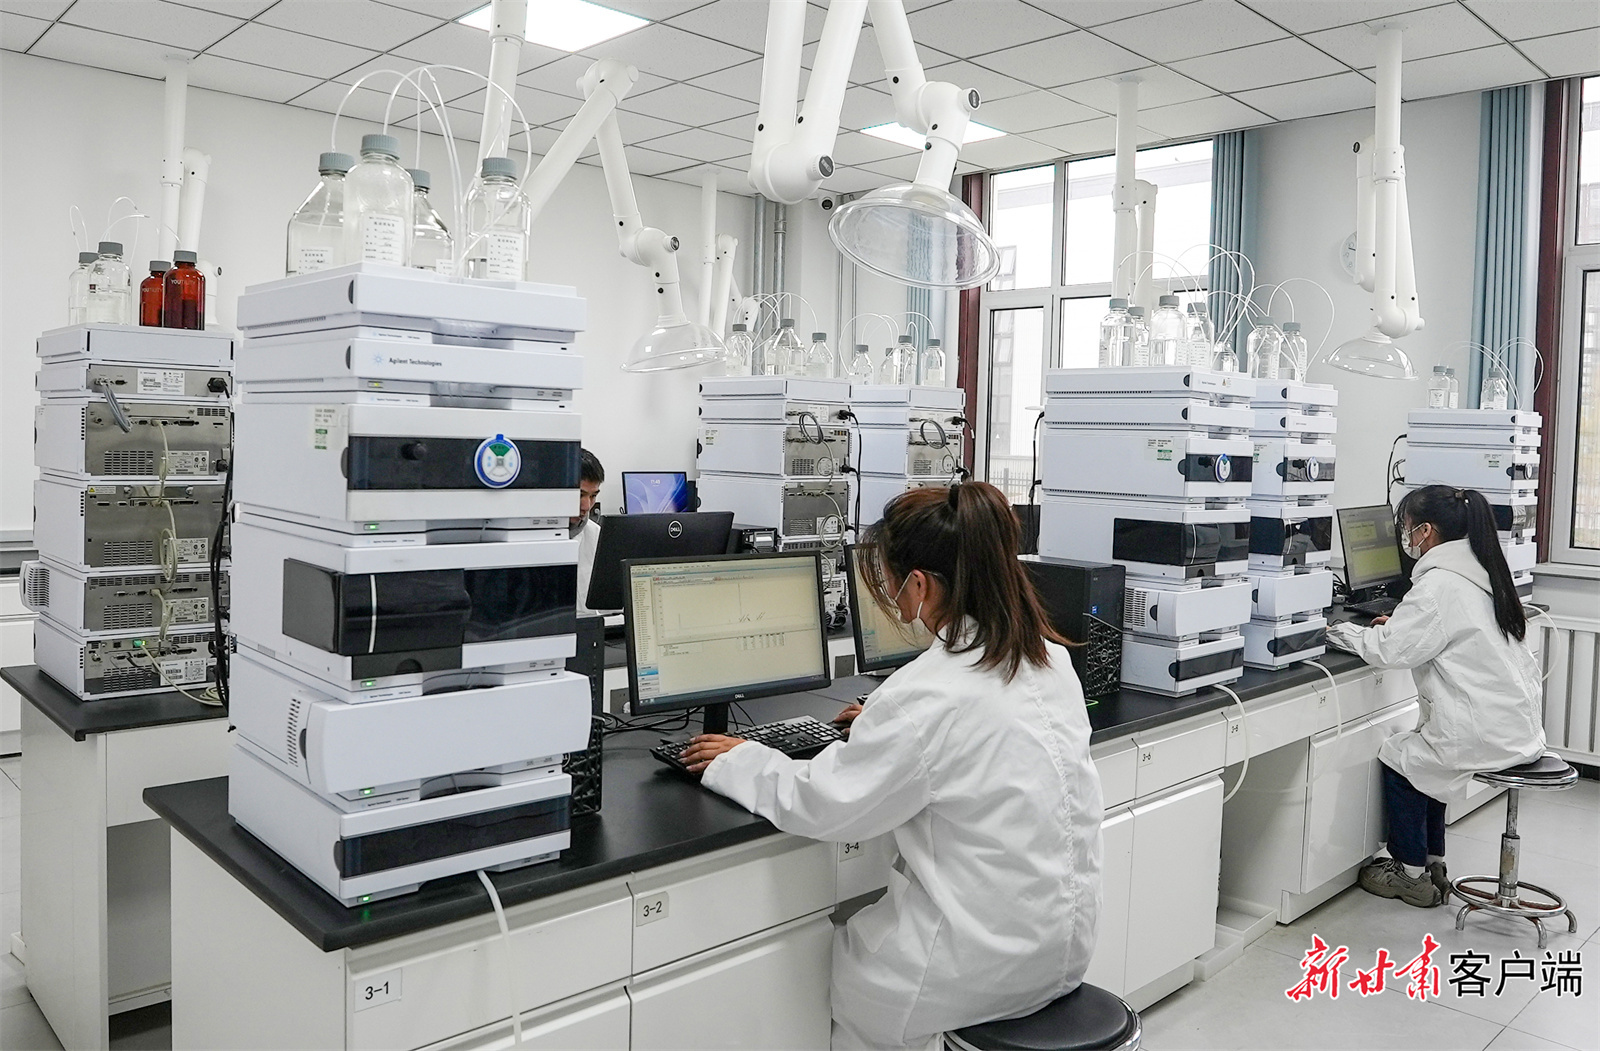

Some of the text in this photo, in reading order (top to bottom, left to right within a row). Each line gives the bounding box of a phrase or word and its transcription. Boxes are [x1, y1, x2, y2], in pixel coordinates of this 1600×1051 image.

[389, 357, 442, 367] Agilent Technologies
[1142, 751, 1152, 763] 3-6
[845, 841, 860, 854] 3-4
[643, 900, 663, 918] 3-2
[365, 980, 389, 1001] 3-1
